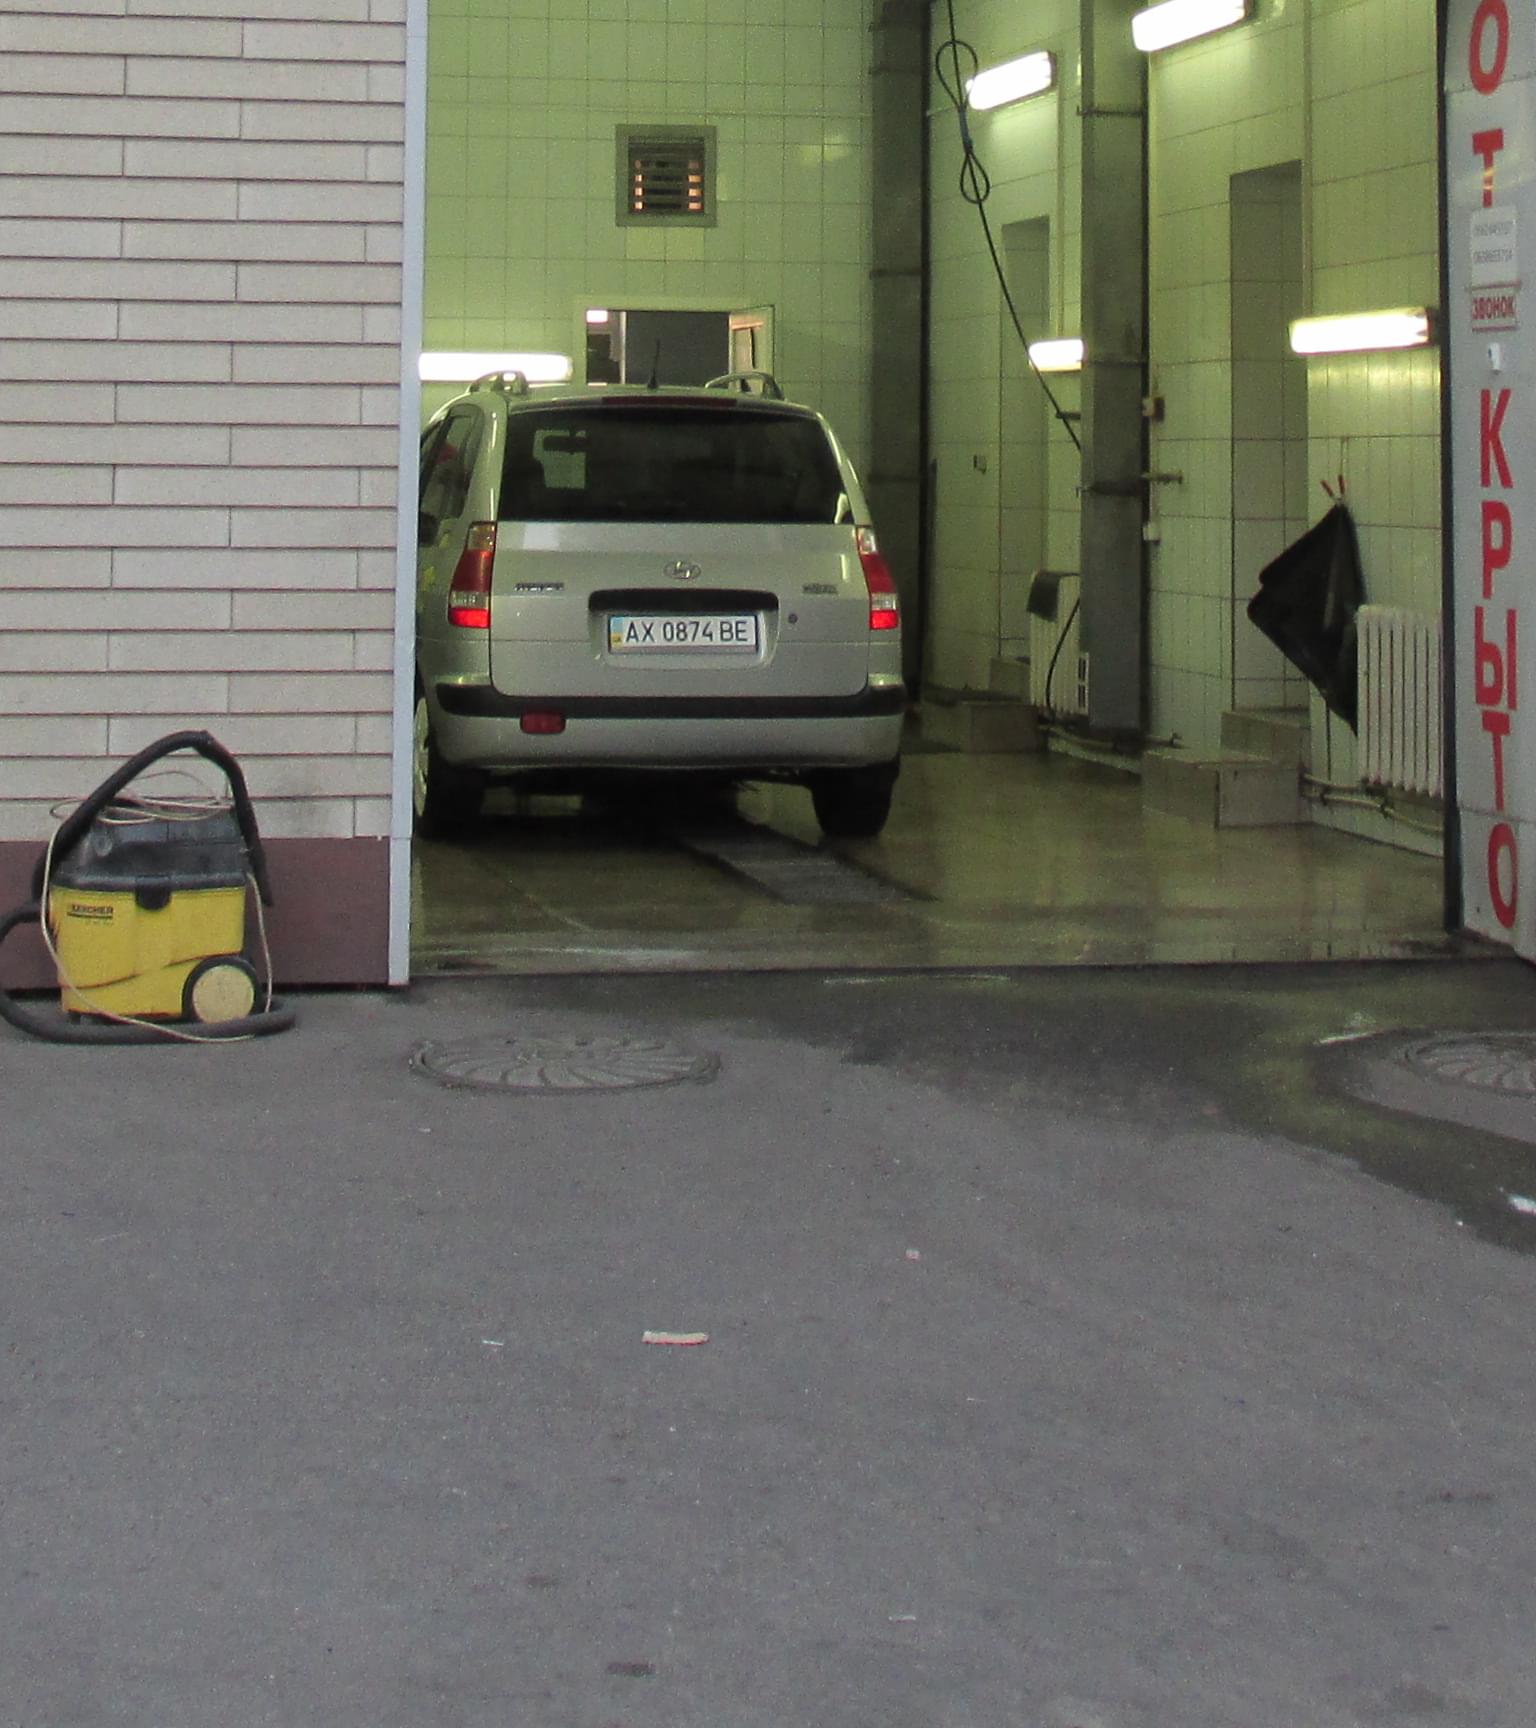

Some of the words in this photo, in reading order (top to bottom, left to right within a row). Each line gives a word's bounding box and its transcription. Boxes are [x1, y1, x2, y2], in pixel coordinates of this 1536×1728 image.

[1472, 295, 1515, 320] ЗВОНОК
[625, 621, 656, 643] AX
[662, 621, 714, 643] 0874
[719, 621, 749, 643] BE
